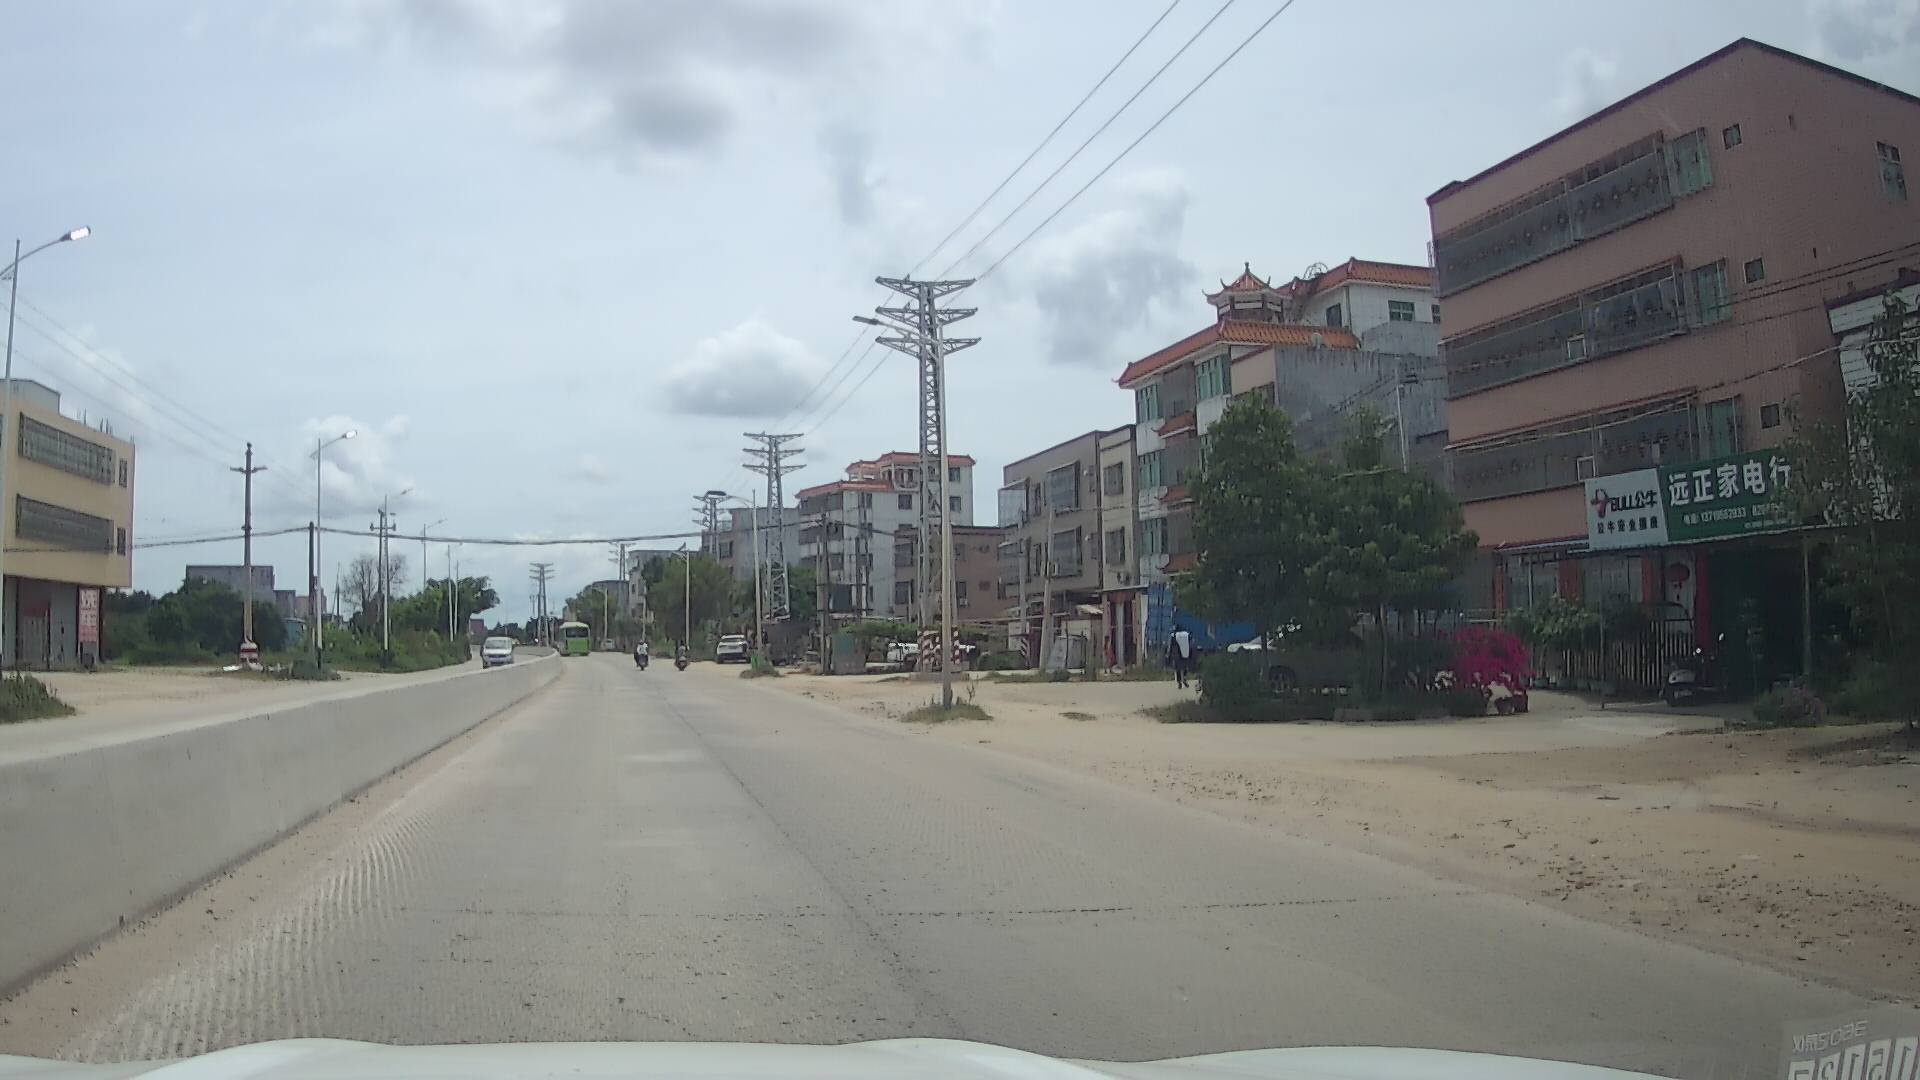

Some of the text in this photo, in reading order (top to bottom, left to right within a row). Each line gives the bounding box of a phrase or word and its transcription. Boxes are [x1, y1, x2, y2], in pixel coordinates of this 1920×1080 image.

[1668, 455, 1792, 507] 远正家电行
